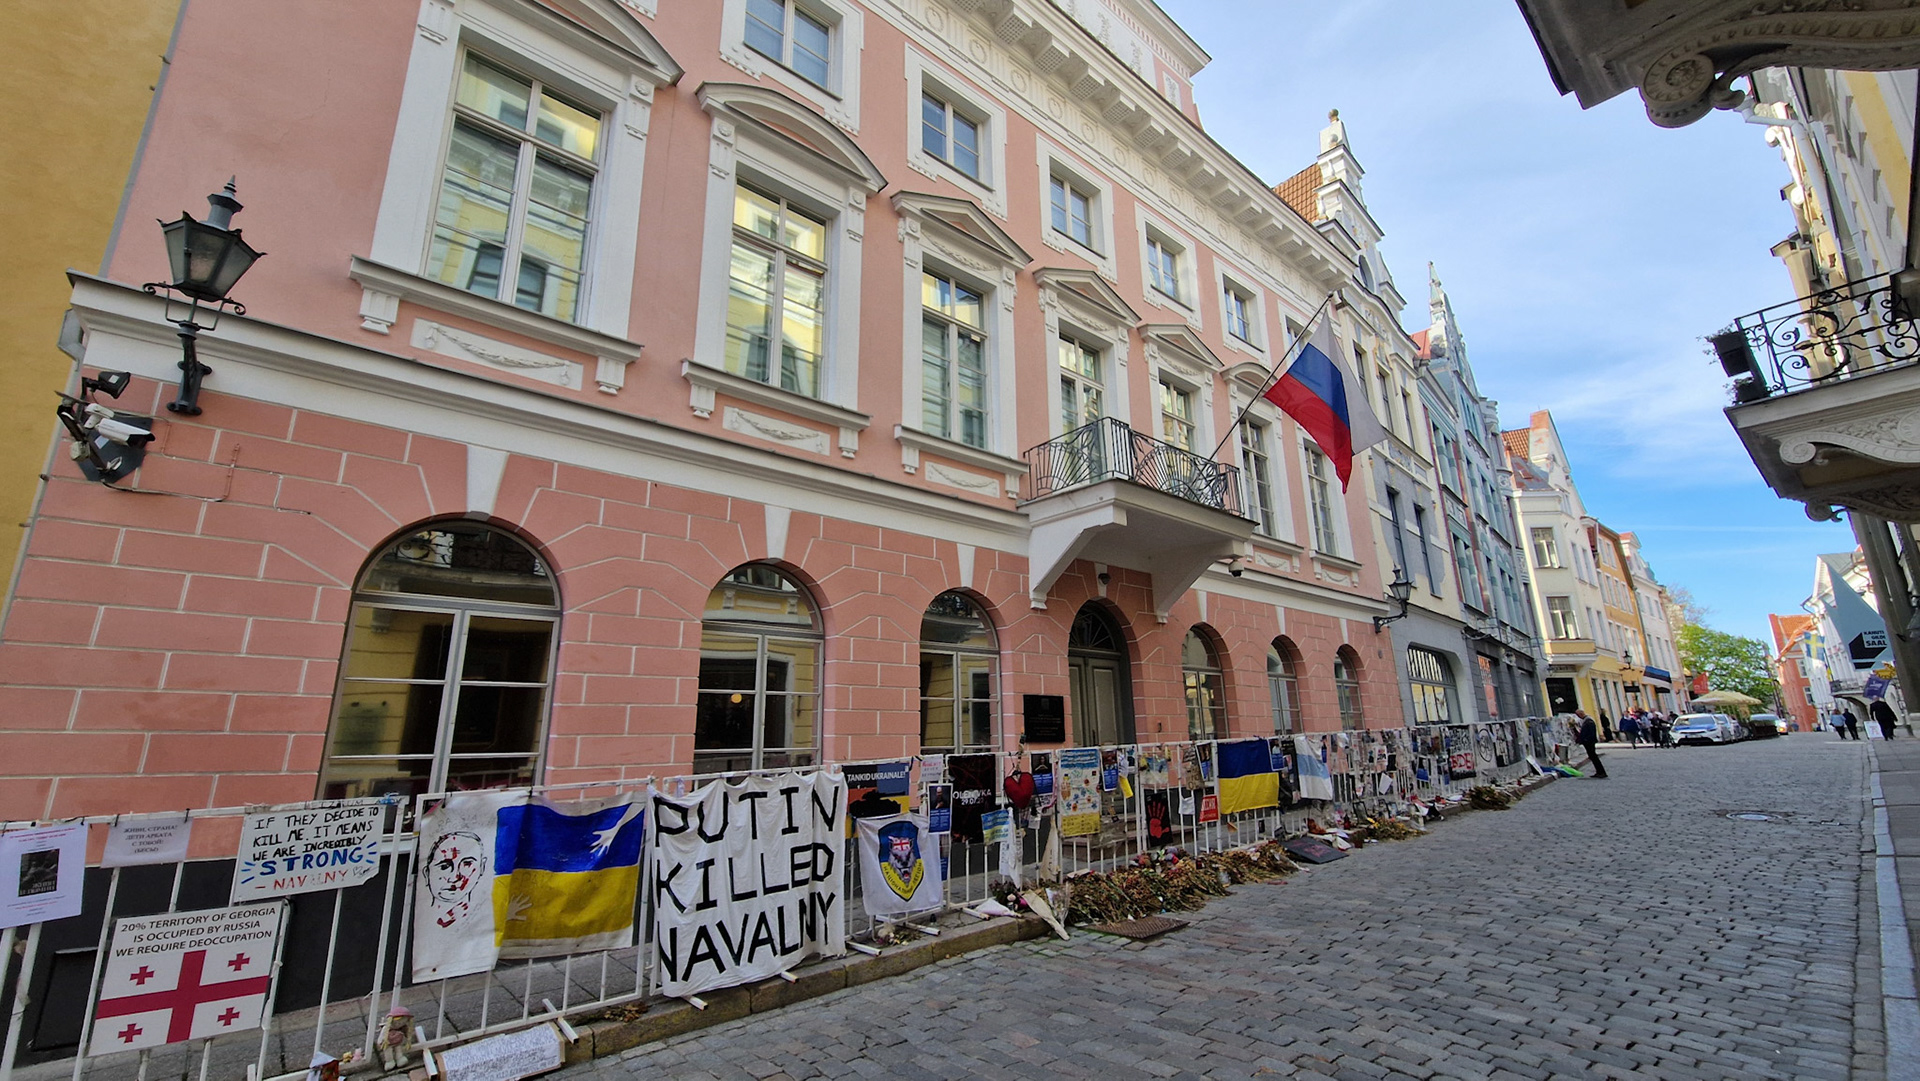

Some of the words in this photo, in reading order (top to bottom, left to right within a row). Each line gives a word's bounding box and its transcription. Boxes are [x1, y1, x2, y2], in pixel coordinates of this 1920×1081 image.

[847, 773, 871, 782] TANKID
[872, 770, 906, 780] UKRAINALE!
[254, 816, 276, 830] IF
[284, 813, 318, 828] THEY
[324, 807, 365, 823] DECIDE
[368, 806, 379, 816] TO
[653, 785, 840, 848] PUTIN
[252, 834, 284, 848] KILL
[314, 825, 332, 838] IT
[335, 820, 374, 835] MEANS
[252, 850, 268, 862] WE
[272, 845, 296, 858] ARE
[302, 834, 367, 853] INCREDIBLY
[259, 847, 364, 876] STRONG
[656, 842, 834, 914] KILLED
[121, 922, 147, 932] 20%
[149, 914, 210, 930] TERRITORY
[212, 912, 228, 922] OF
[229, 906, 276, 920] GEORGIA
[133, 934, 144, 943] IS
[146, 927, 205, 942] OCCUPIED
[206, 924, 222, 934] BY
[224, 920, 261, 932] RUSSIA
[116, 947, 135, 958] WE
[136, 941, 186, 955] REQUIRE
[188, 930, 273, 948] DEOCCUPATION
[656, 891, 836, 983] NAVALNY
